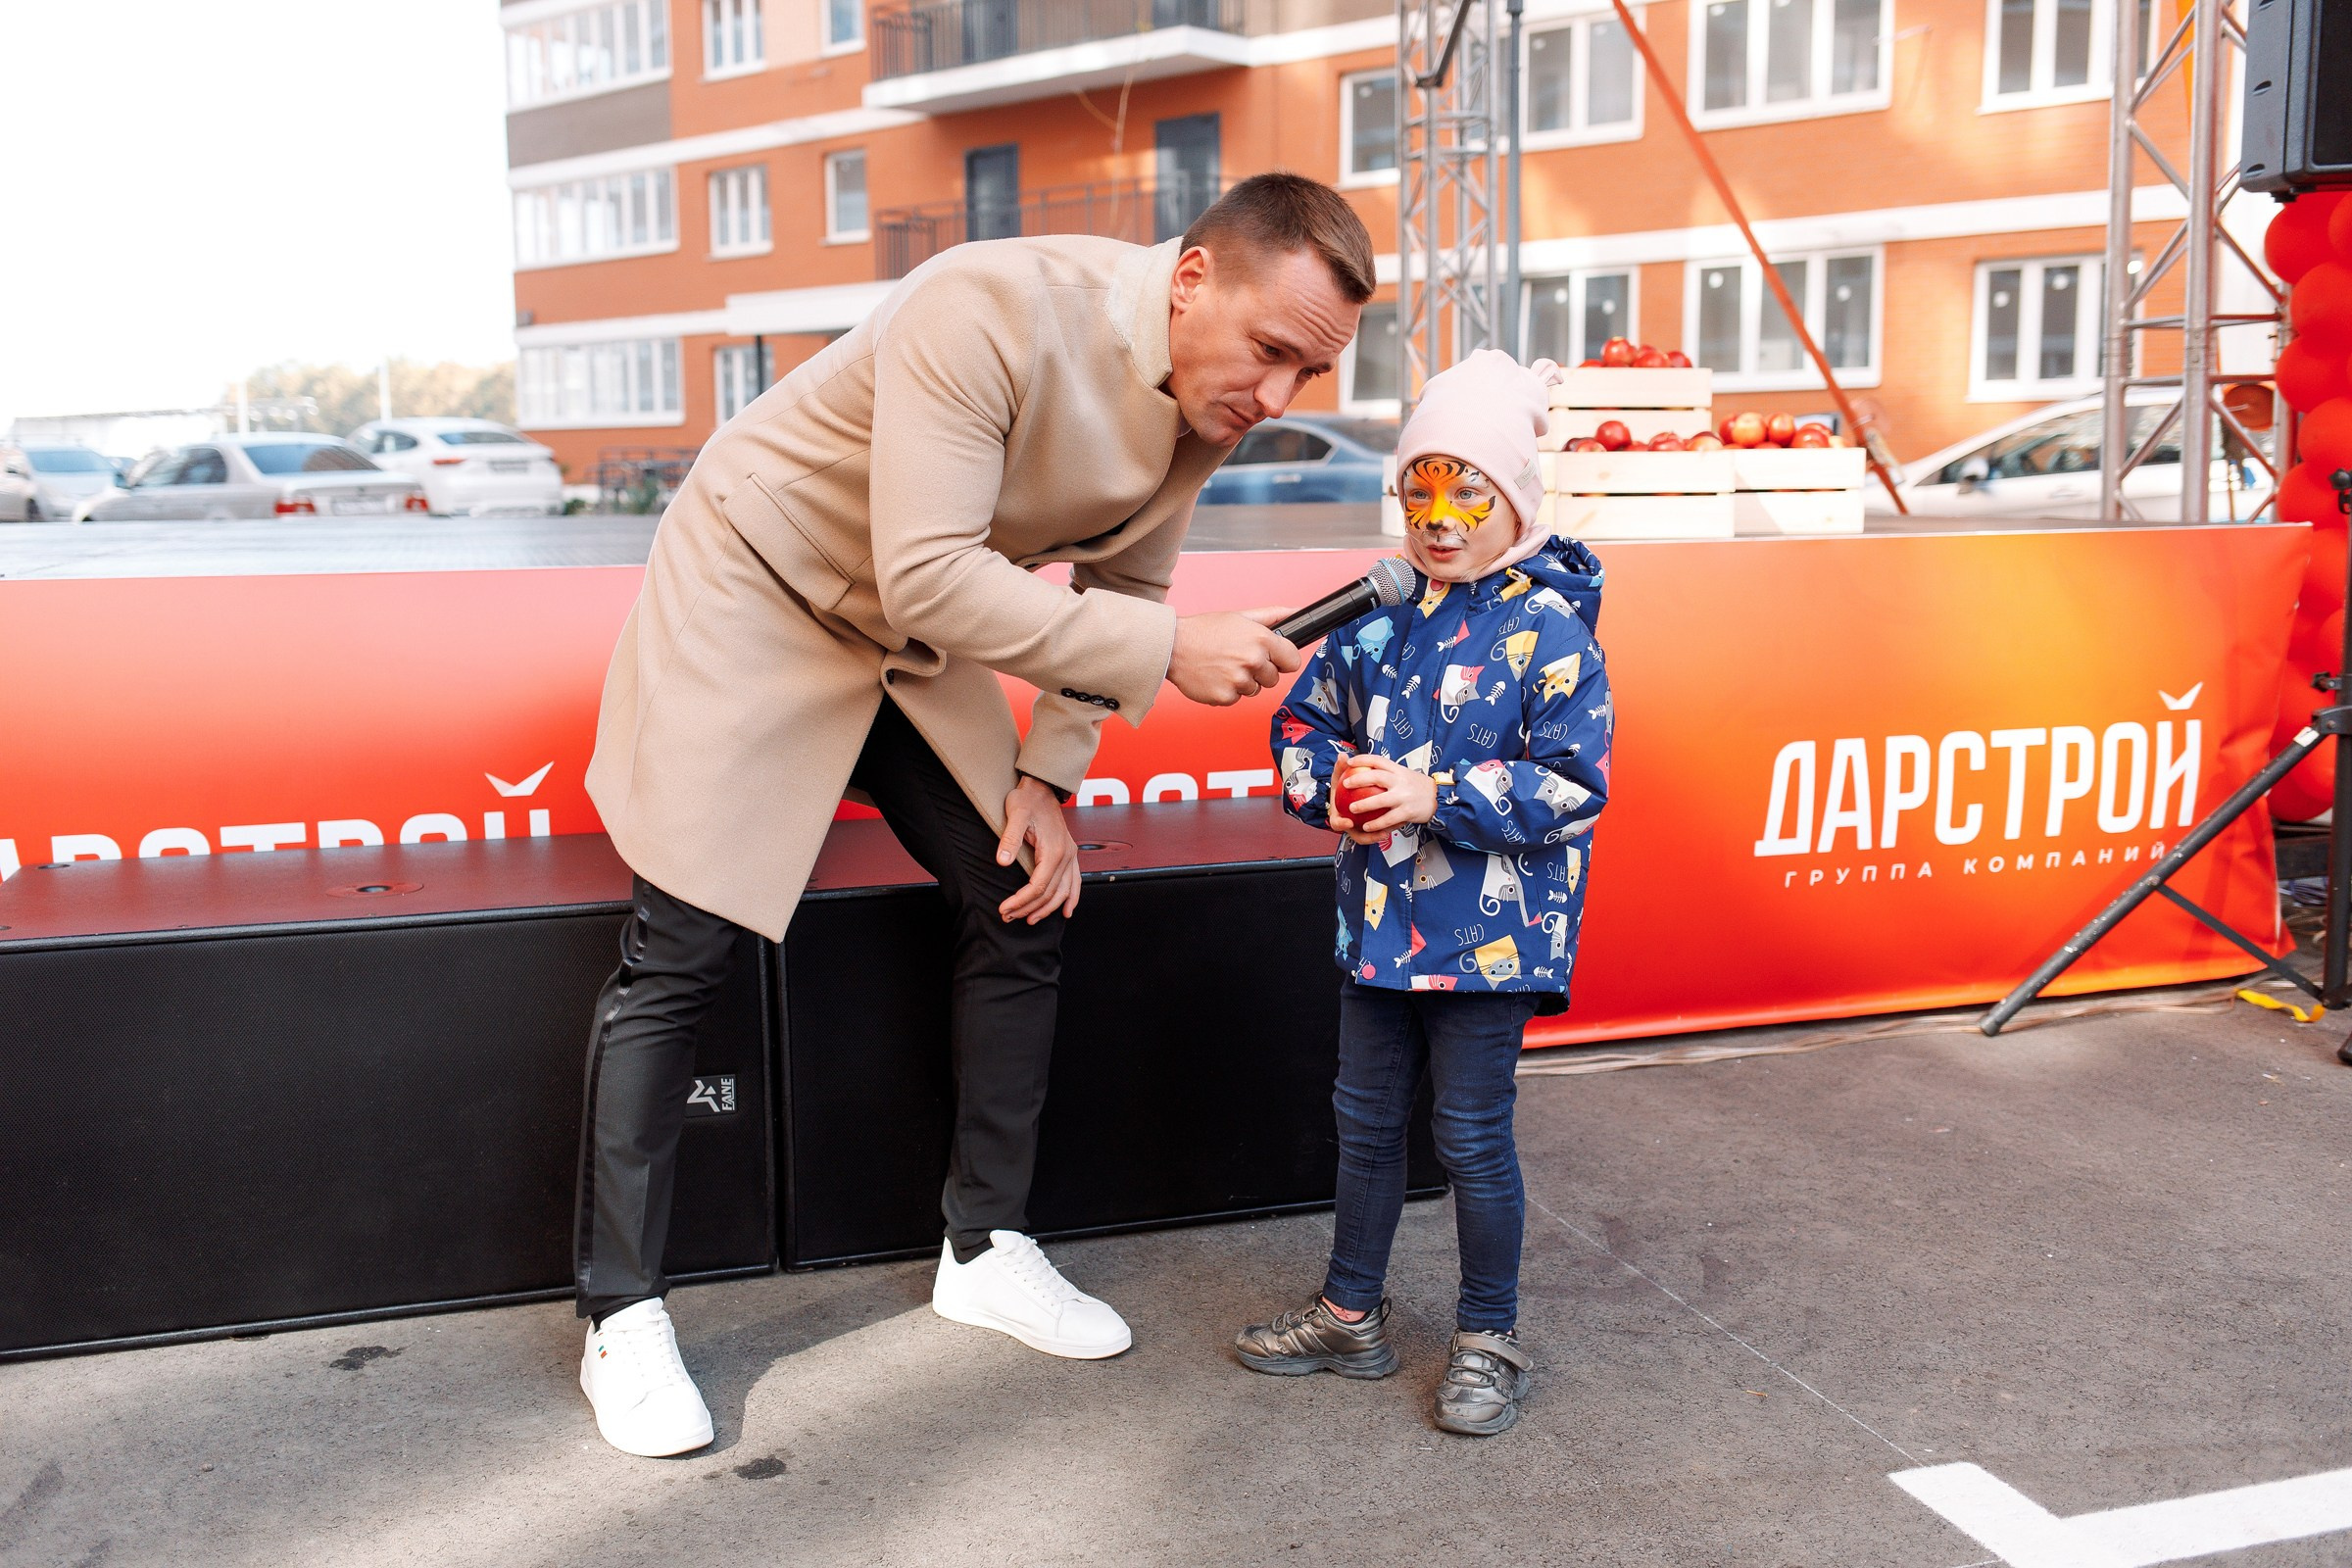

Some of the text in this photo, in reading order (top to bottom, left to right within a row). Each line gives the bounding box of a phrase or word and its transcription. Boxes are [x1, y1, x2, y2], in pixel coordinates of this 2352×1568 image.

[1390, 709, 1414, 740] CATS
[1467, 722, 1497, 749] CATS
[1539, 720, 1568, 742] CATS
[1754, 682, 2203, 858] ДАРСТРОЙ
[1785, 841, 2167, 889] ГРУППА КОМПАНИЙ
[1455, 923, 1485, 946] CATS
[720, 1077, 734, 1111] FANE
